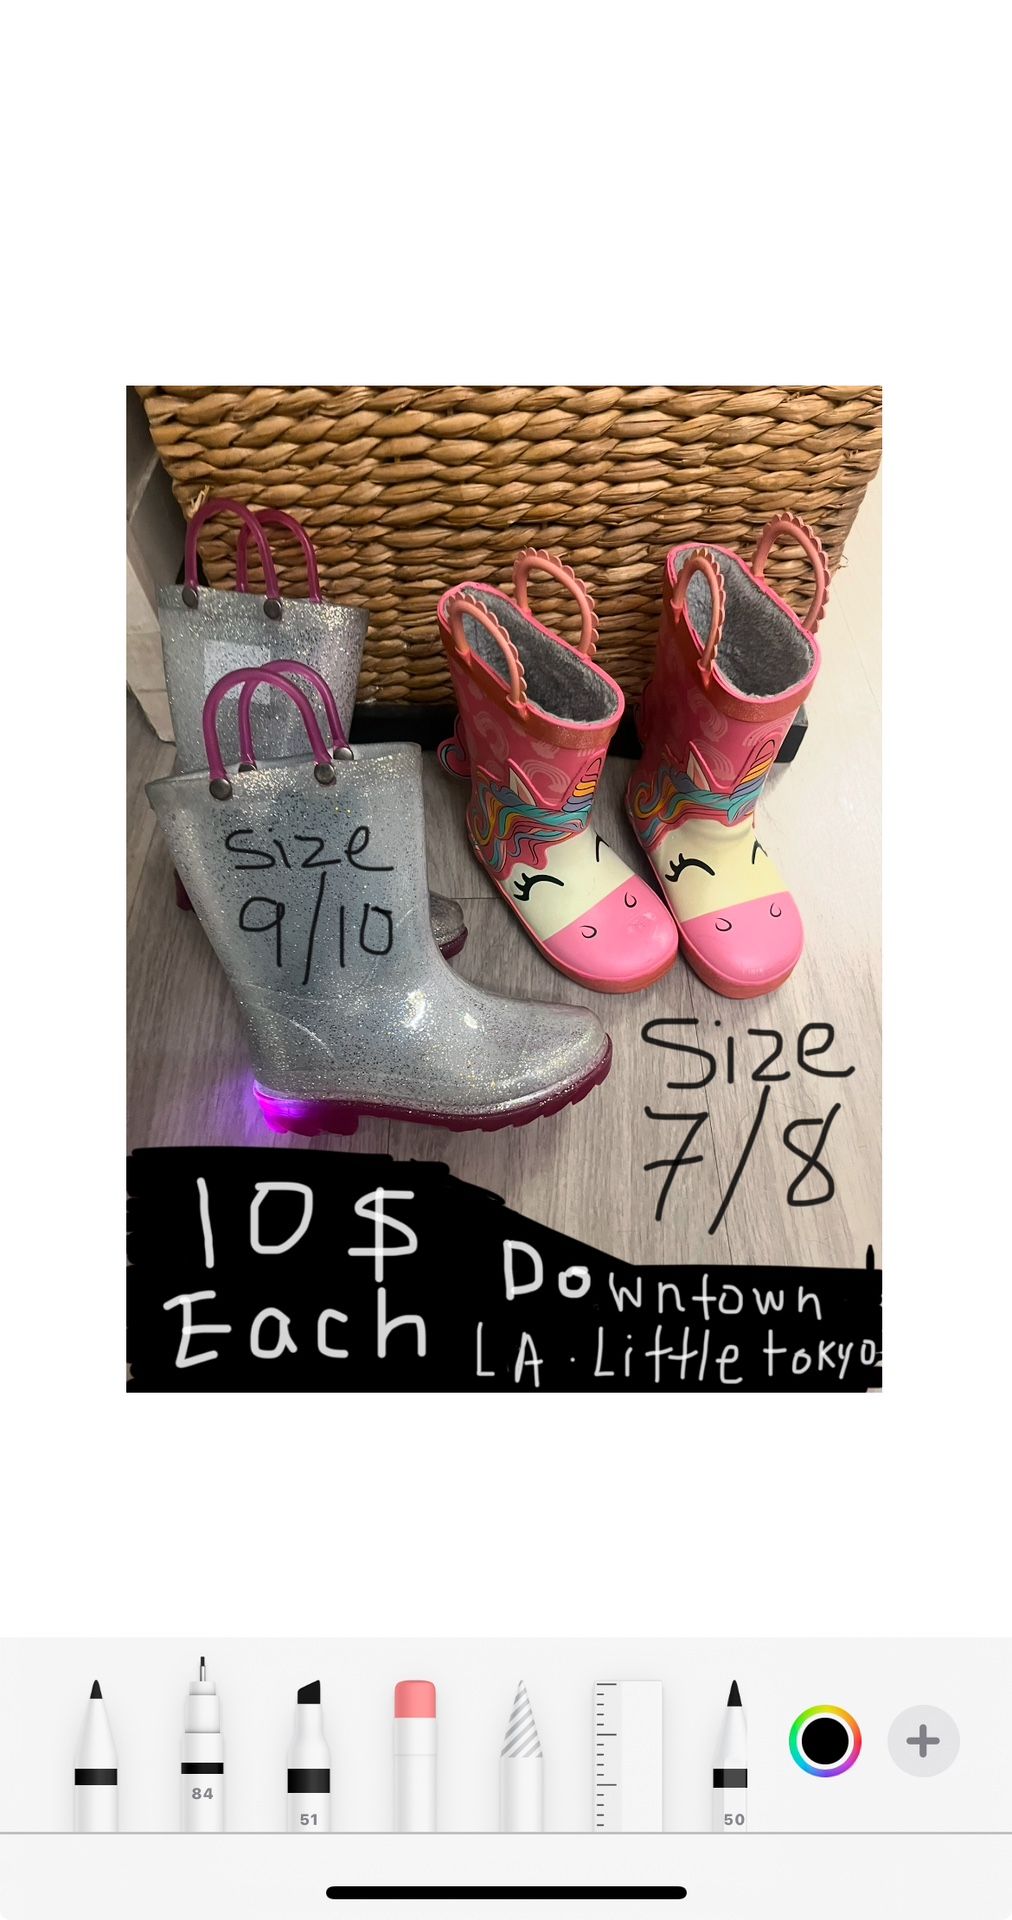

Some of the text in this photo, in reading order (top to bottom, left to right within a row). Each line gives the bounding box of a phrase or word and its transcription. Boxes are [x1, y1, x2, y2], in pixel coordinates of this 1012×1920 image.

[191, 1787, 214, 1800] 84
[299, 1813, 318, 1826] 51
[723, 1813, 746, 1826] 50
